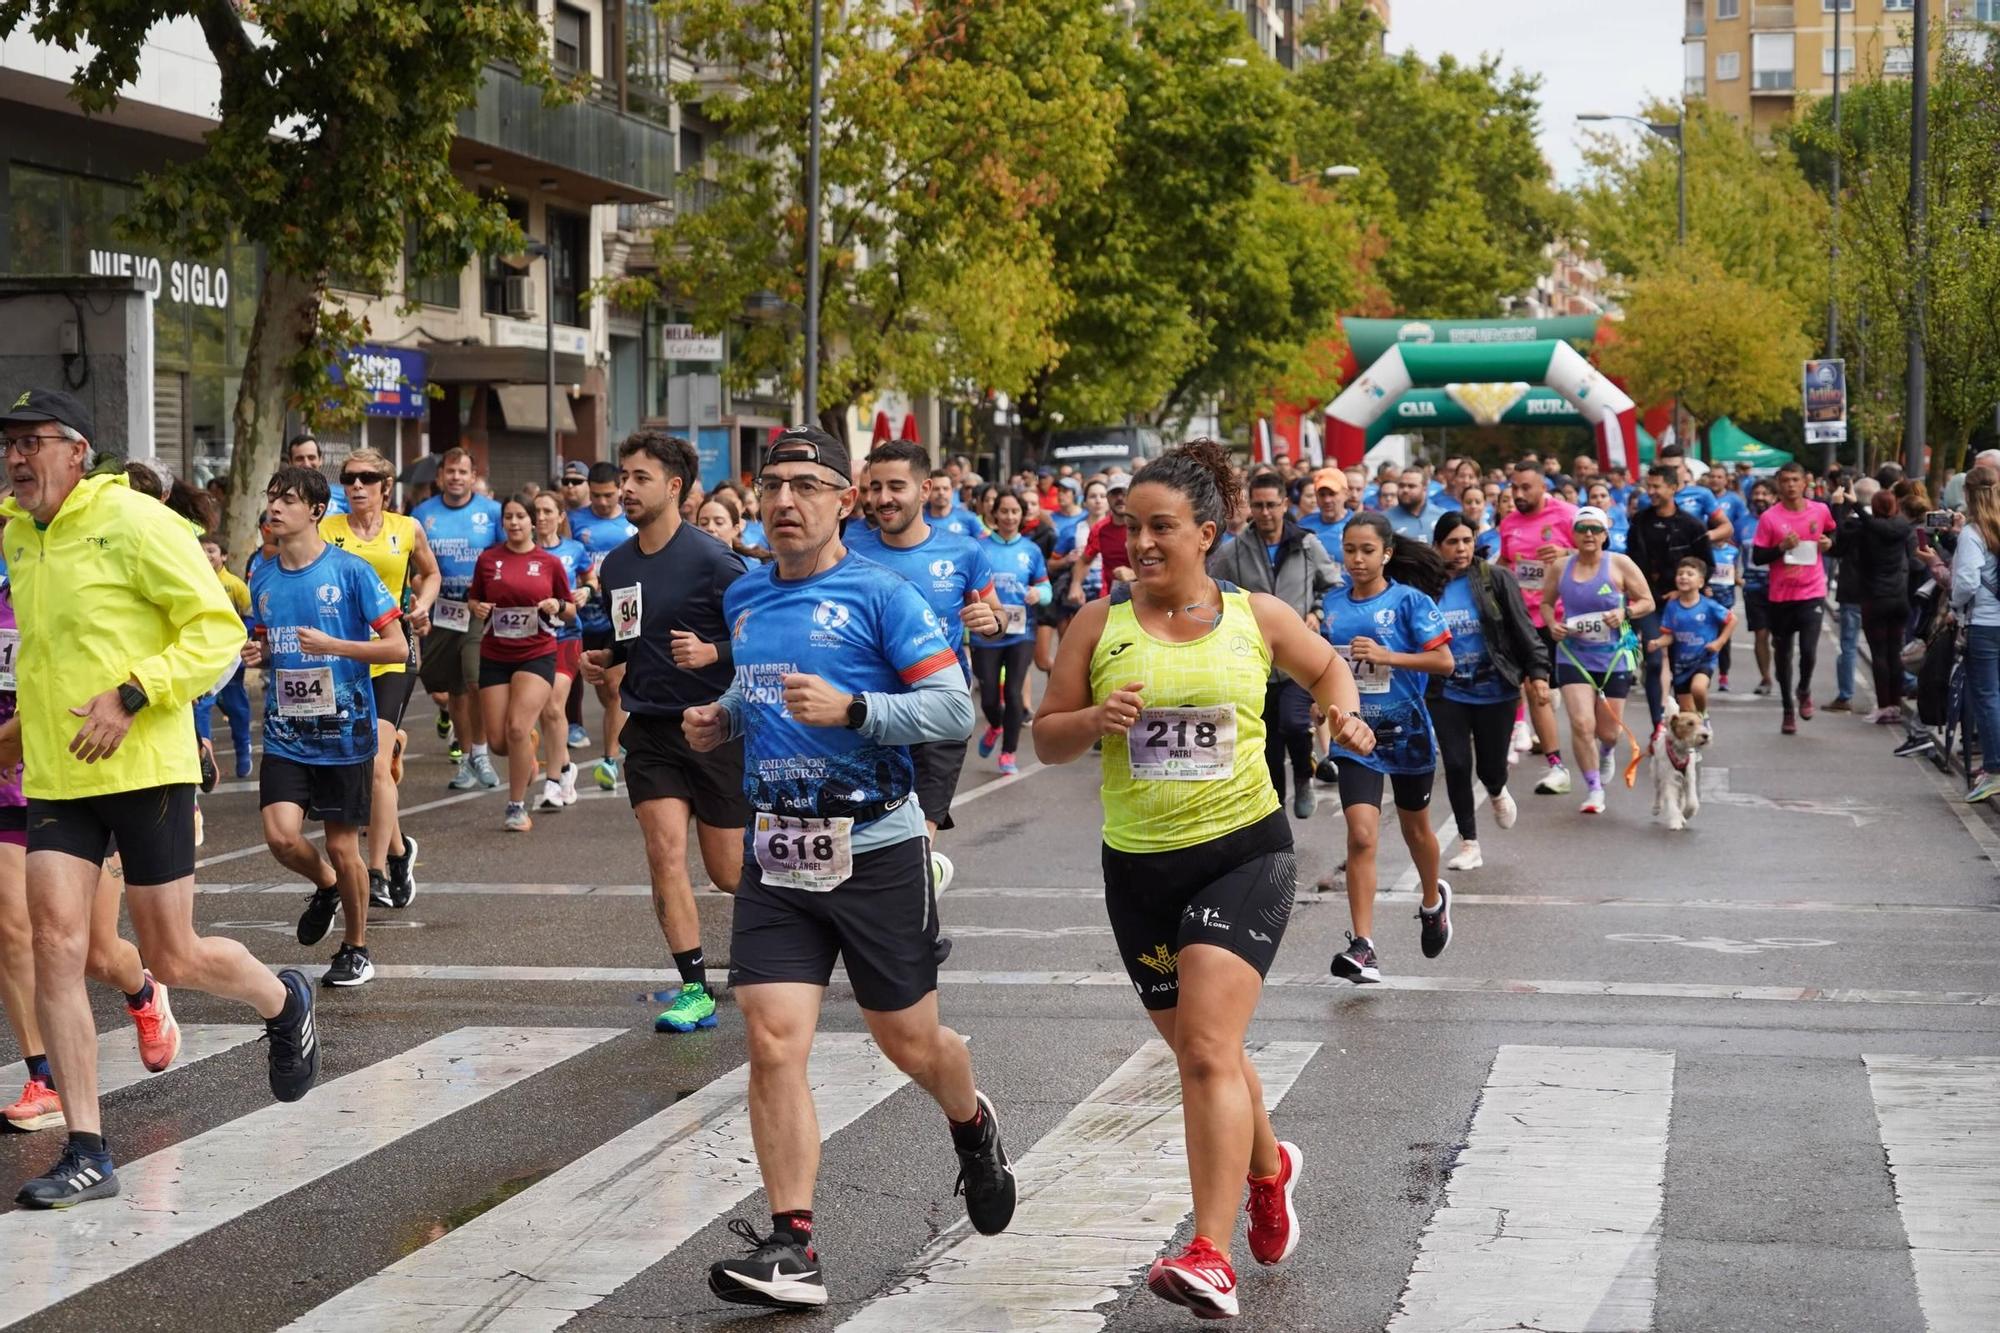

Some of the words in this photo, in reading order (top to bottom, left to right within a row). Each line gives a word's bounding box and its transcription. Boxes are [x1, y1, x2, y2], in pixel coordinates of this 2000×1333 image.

[170, 260, 229, 309] SIGLO
[1398, 401, 1438, 417] CAJA
[1521, 566, 1544, 577] 328
[441, 606, 464, 618] 675
[621, 600, 638, 622] 94
[500, 614, 530, 625] 427
[1576, 620, 1602, 633] 956
[754, 662, 799, 675] CARRERA
[284, 680, 323, 698] 584
[1145, 720, 1217, 748] 218
[1169, 750, 1192, 759] PATRI
[768, 833, 834, 861] 618
